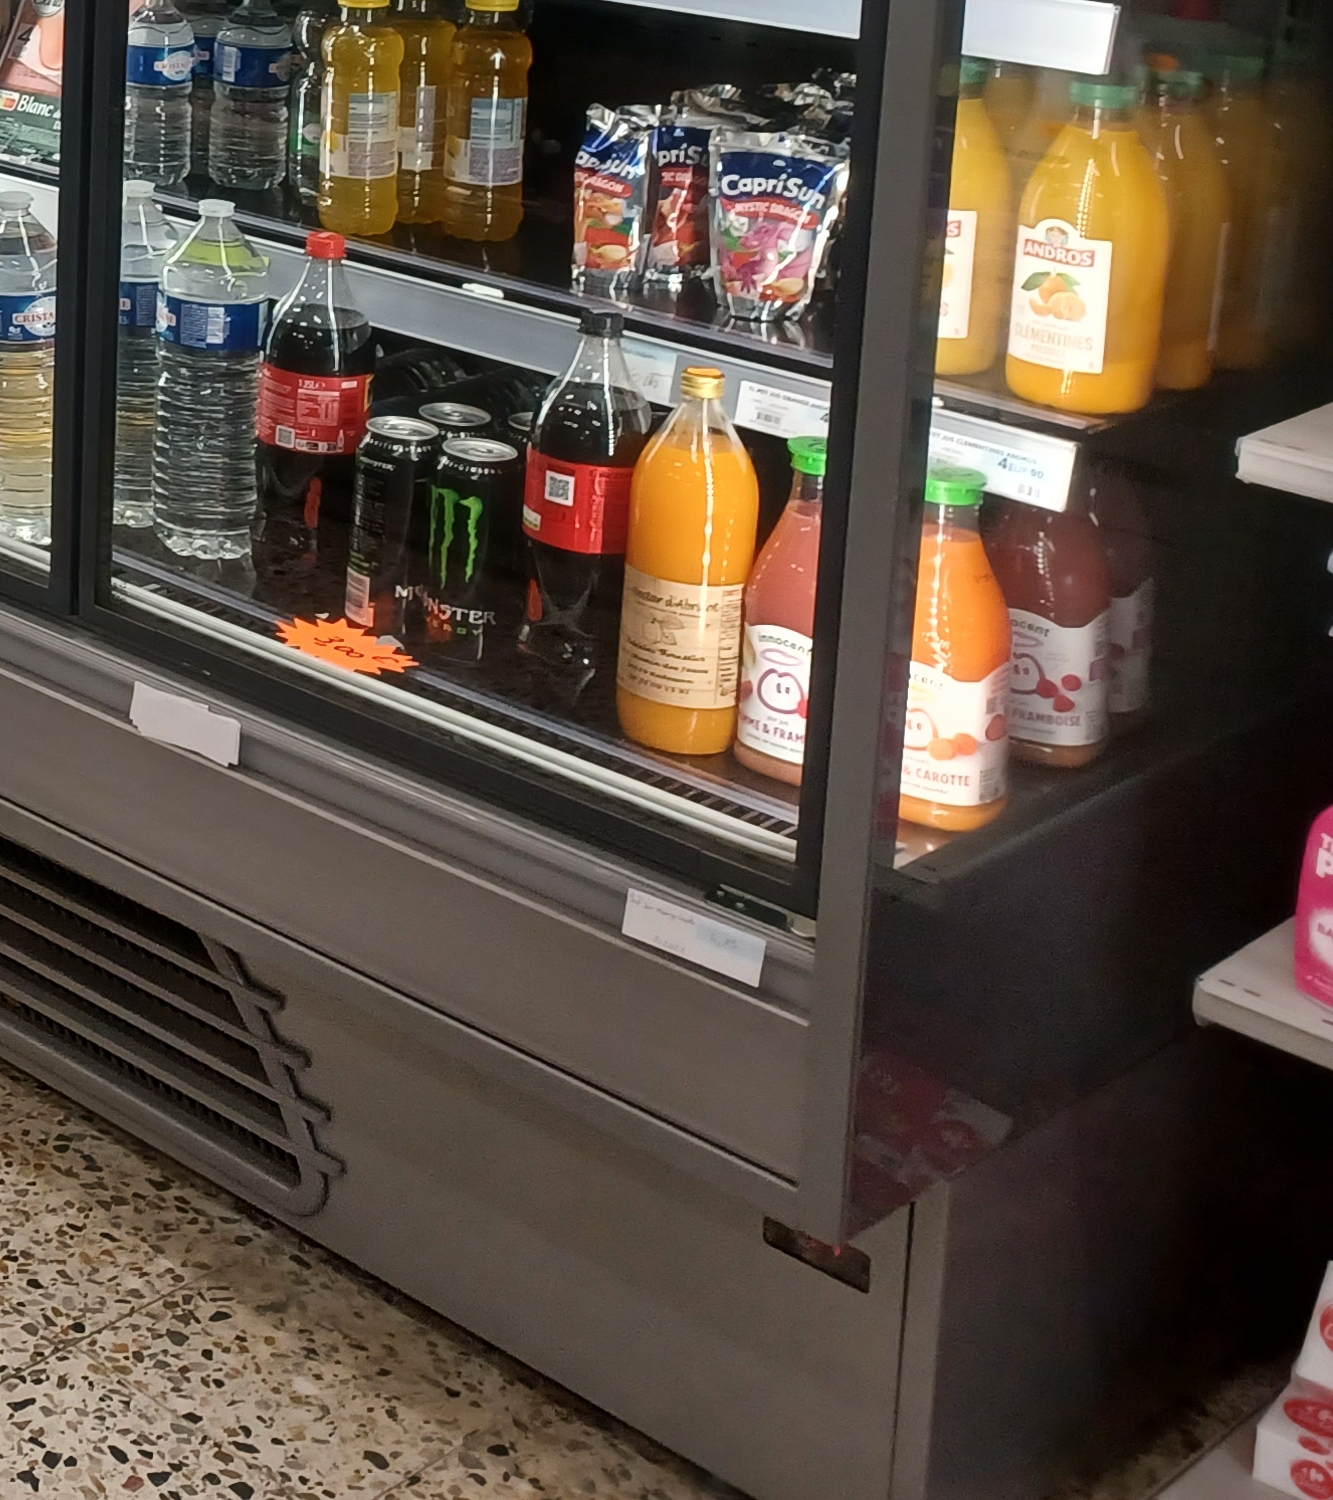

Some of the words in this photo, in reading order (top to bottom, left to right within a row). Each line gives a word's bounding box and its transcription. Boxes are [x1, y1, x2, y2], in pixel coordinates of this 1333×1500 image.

[17, 94, 54, 118] Blanc
[721, 173, 825, 211] CapriSun
[1023, 239, 1094, 267] ANDROS
[15, 313, 54, 324] CRISTA
[998, 457, 1008, 470] 4
[758, 631, 813, 657] innocent
[762, 724, 771, 736] &
[772, 727, 805, 745] FRAM
[916, 769, 971, 788] CAROTTE
